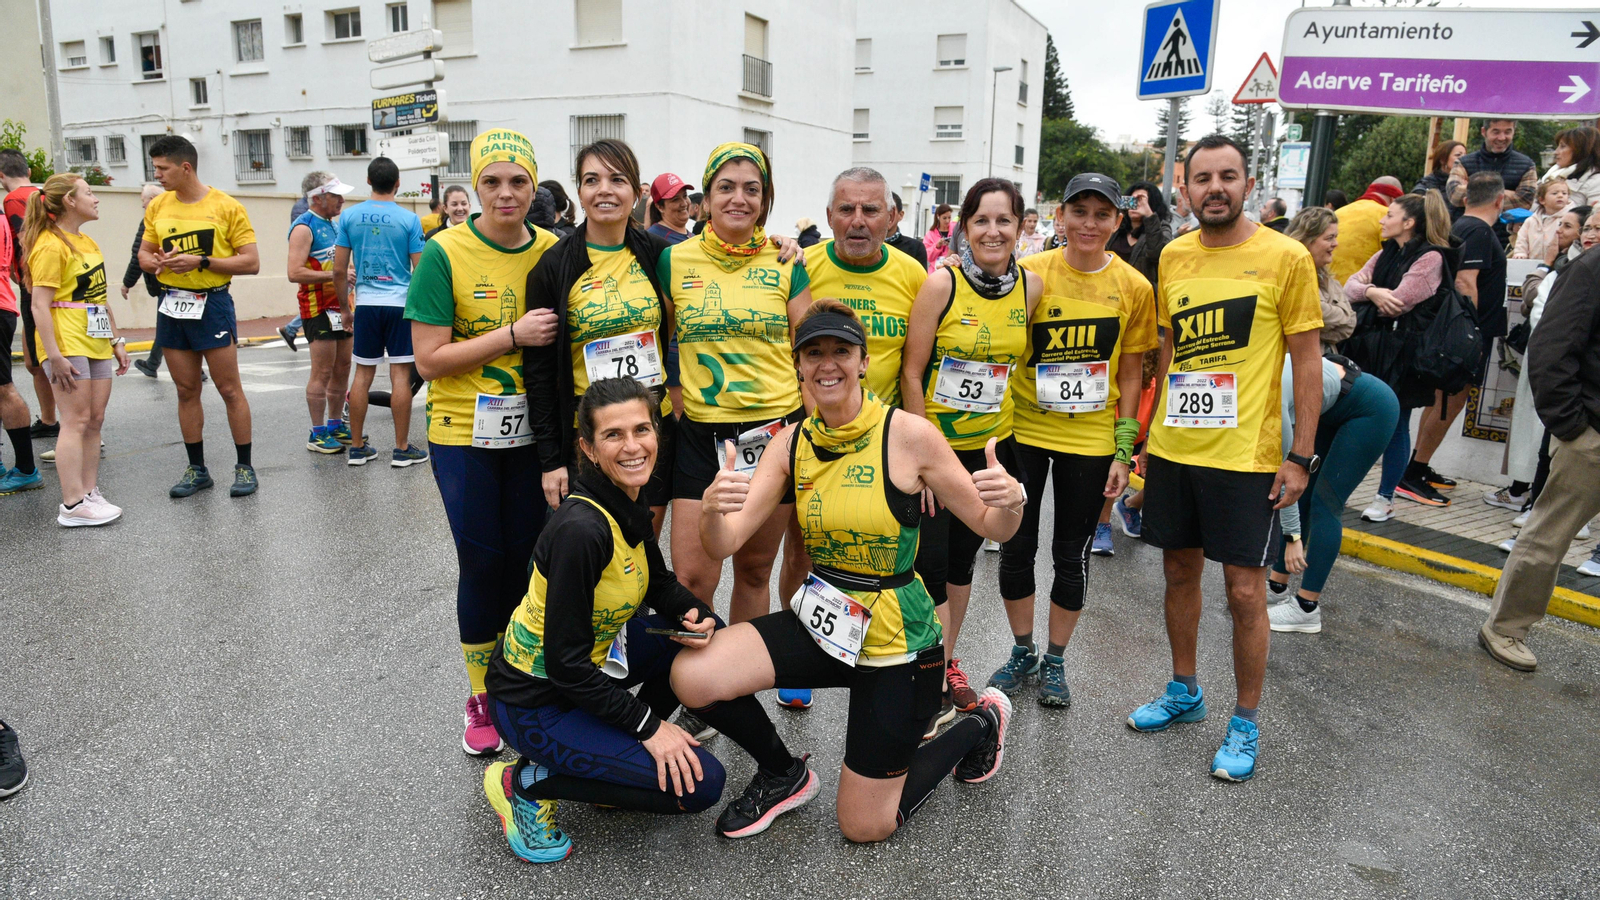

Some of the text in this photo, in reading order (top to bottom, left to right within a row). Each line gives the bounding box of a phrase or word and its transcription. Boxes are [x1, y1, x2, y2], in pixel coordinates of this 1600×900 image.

[1303, 21, 1453, 44] Ayuntamiento
[1294, 71, 1467, 94] Adarve Tarifeño
[373, 93, 436, 109] TURMARES Tickets
[408, 147, 437, 155] Polideportivo
[361, 213, 391, 224] FGC
[170, 233, 199, 253] XIII
[174, 300, 195, 313] 107
[837, 298, 877, 311] NNERS
[1178, 307, 1224, 343] XIII
[1045, 324, 1097, 351] XIII
[1203, 334, 1230, 344] Estrecho
[1210, 340, 1236, 348] Serrano
[595, 341, 610, 351] XIII
[951, 361, 967, 369] XIII
[1065, 354, 1081, 362] Pepe
[1199, 355, 1227, 365] TARIFA
[611, 354, 639, 378] 78
[958, 378, 984, 400] 53
[1060, 380, 1084, 401] 84
[487, 398, 504, 407] XIII
[1179, 392, 1214, 415] 289
[500, 413, 525, 436] 57
[813, 581, 825, 592] XIII
[810, 604, 838, 637] 55
[919, 659, 945, 670] WONG
[503, 767, 513, 798] HOKA
